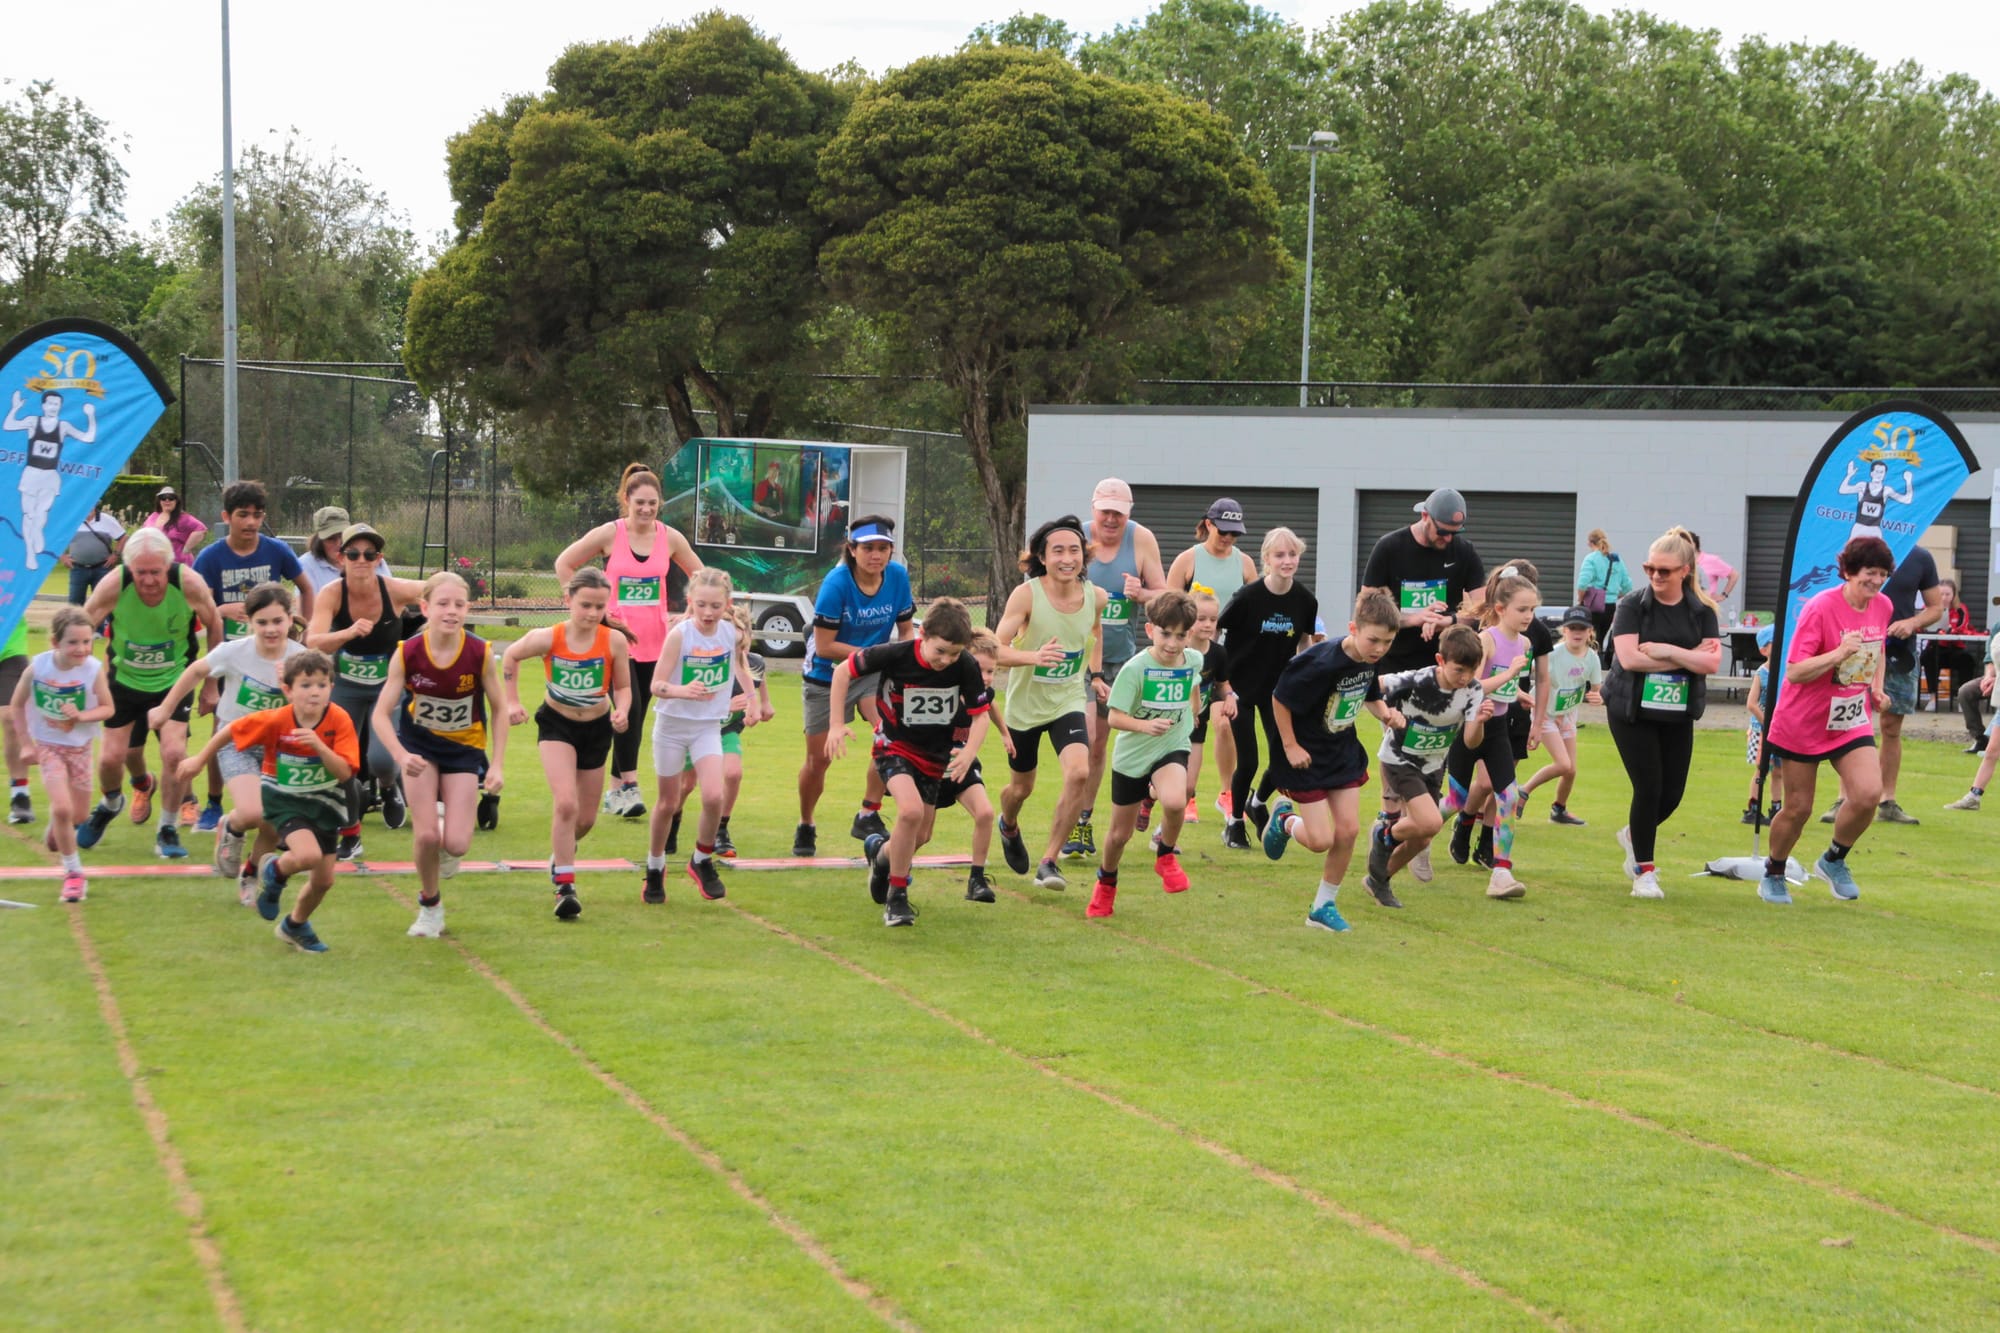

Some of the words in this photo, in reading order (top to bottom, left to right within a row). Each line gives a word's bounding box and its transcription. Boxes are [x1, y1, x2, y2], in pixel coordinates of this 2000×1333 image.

[39, 344, 97, 379] 50
[1869, 421, 1917, 451] 50
[39, 444, 53, 455] W
[59, 461, 102, 480] WATT
[1866, 505, 1877, 514] W
[1816, 505, 1855, 523] GEOFF
[1881, 519, 1916, 535] WATT
[625, 586, 653, 600] 229
[1411, 591, 1437, 607] 216
[1101, 603, 1122, 618] 19
[133, 651, 165, 664] 228
[347, 663, 378, 679] 222
[693, 666, 723, 686] 204
[1046, 661, 1074, 677] 221
[559, 670, 595, 689] 206
[246, 692, 284, 710] 230
[1154, 682, 1184, 702] 218
[1652, 685, 1681, 703] 226
[43, 694, 77, 713] 205
[419, 701, 468, 723] 232
[910, 695, 954, 714] 231
[1832, 699, 1863, 721] 235
[1414, 735, 1446, 749] 223
[288, 766, 327, 785] 224
